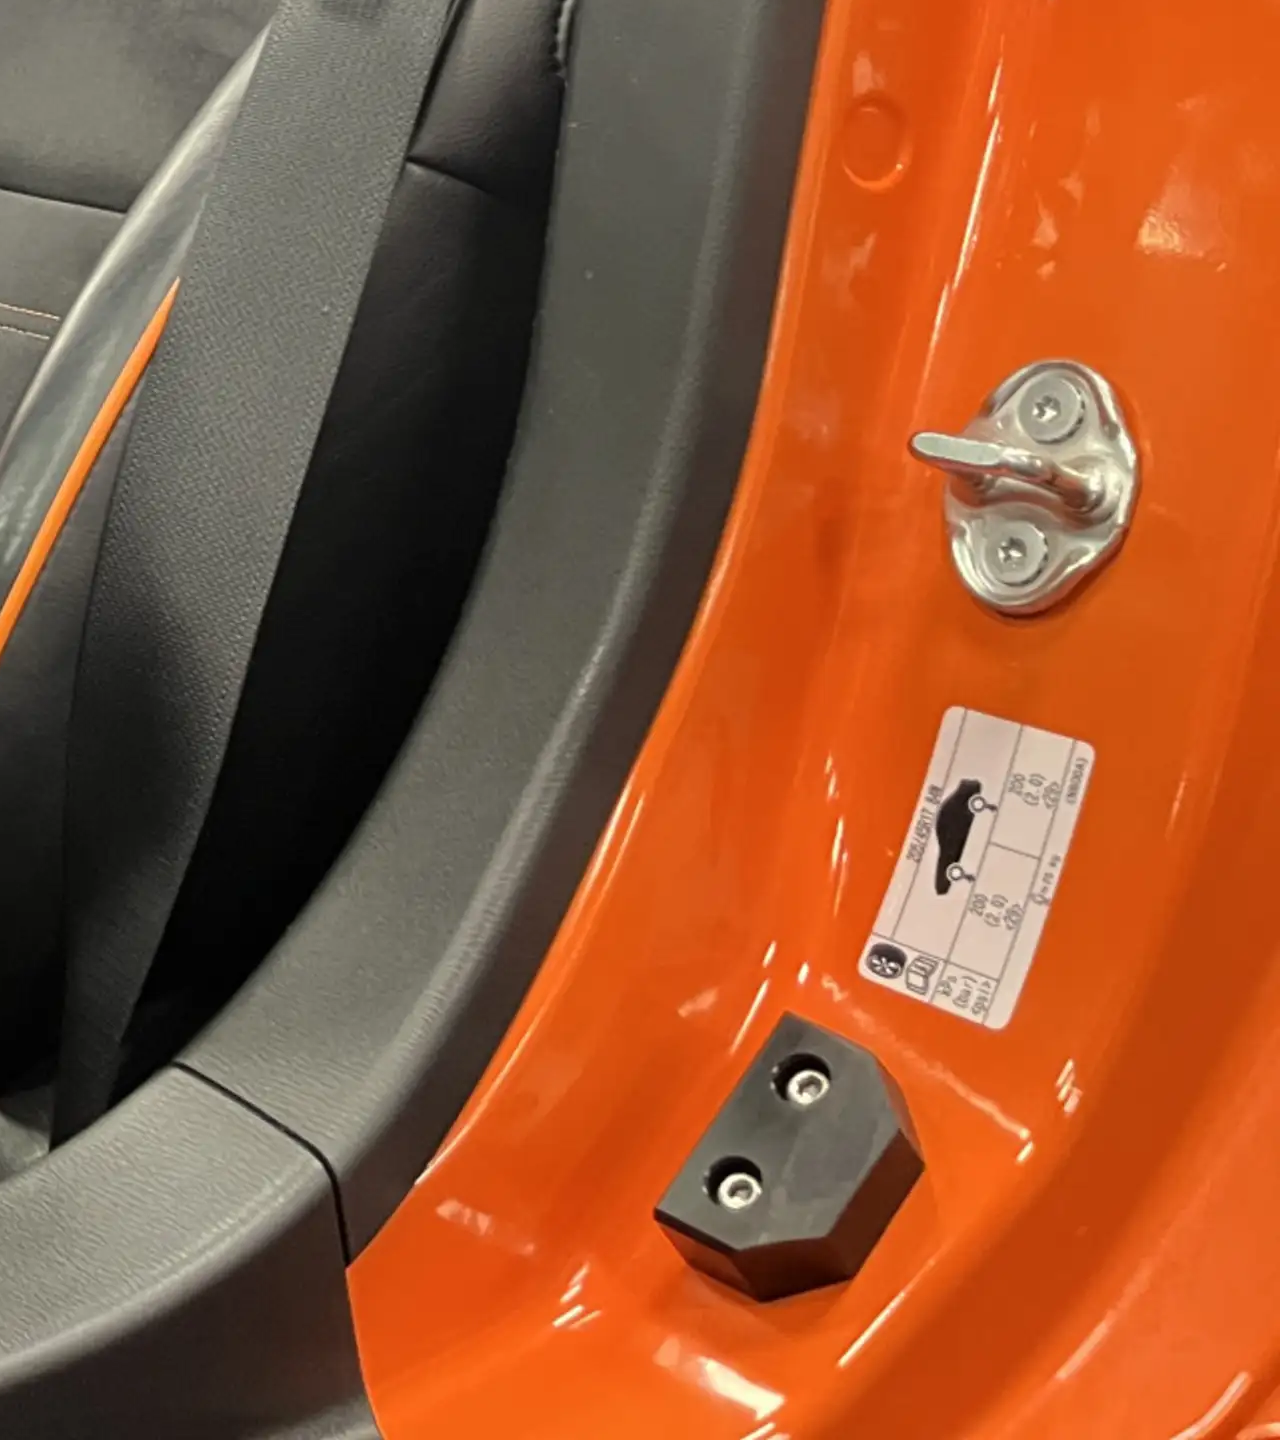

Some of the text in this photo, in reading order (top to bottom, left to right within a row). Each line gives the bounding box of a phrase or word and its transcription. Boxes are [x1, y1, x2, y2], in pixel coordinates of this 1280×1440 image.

[1008, 773, 1026, 795] 200
[1023, 773, 1046, 806] (2.0)
[969, 894, 988, 916] 200
[984, 894, 1008, 927] (2.0)
